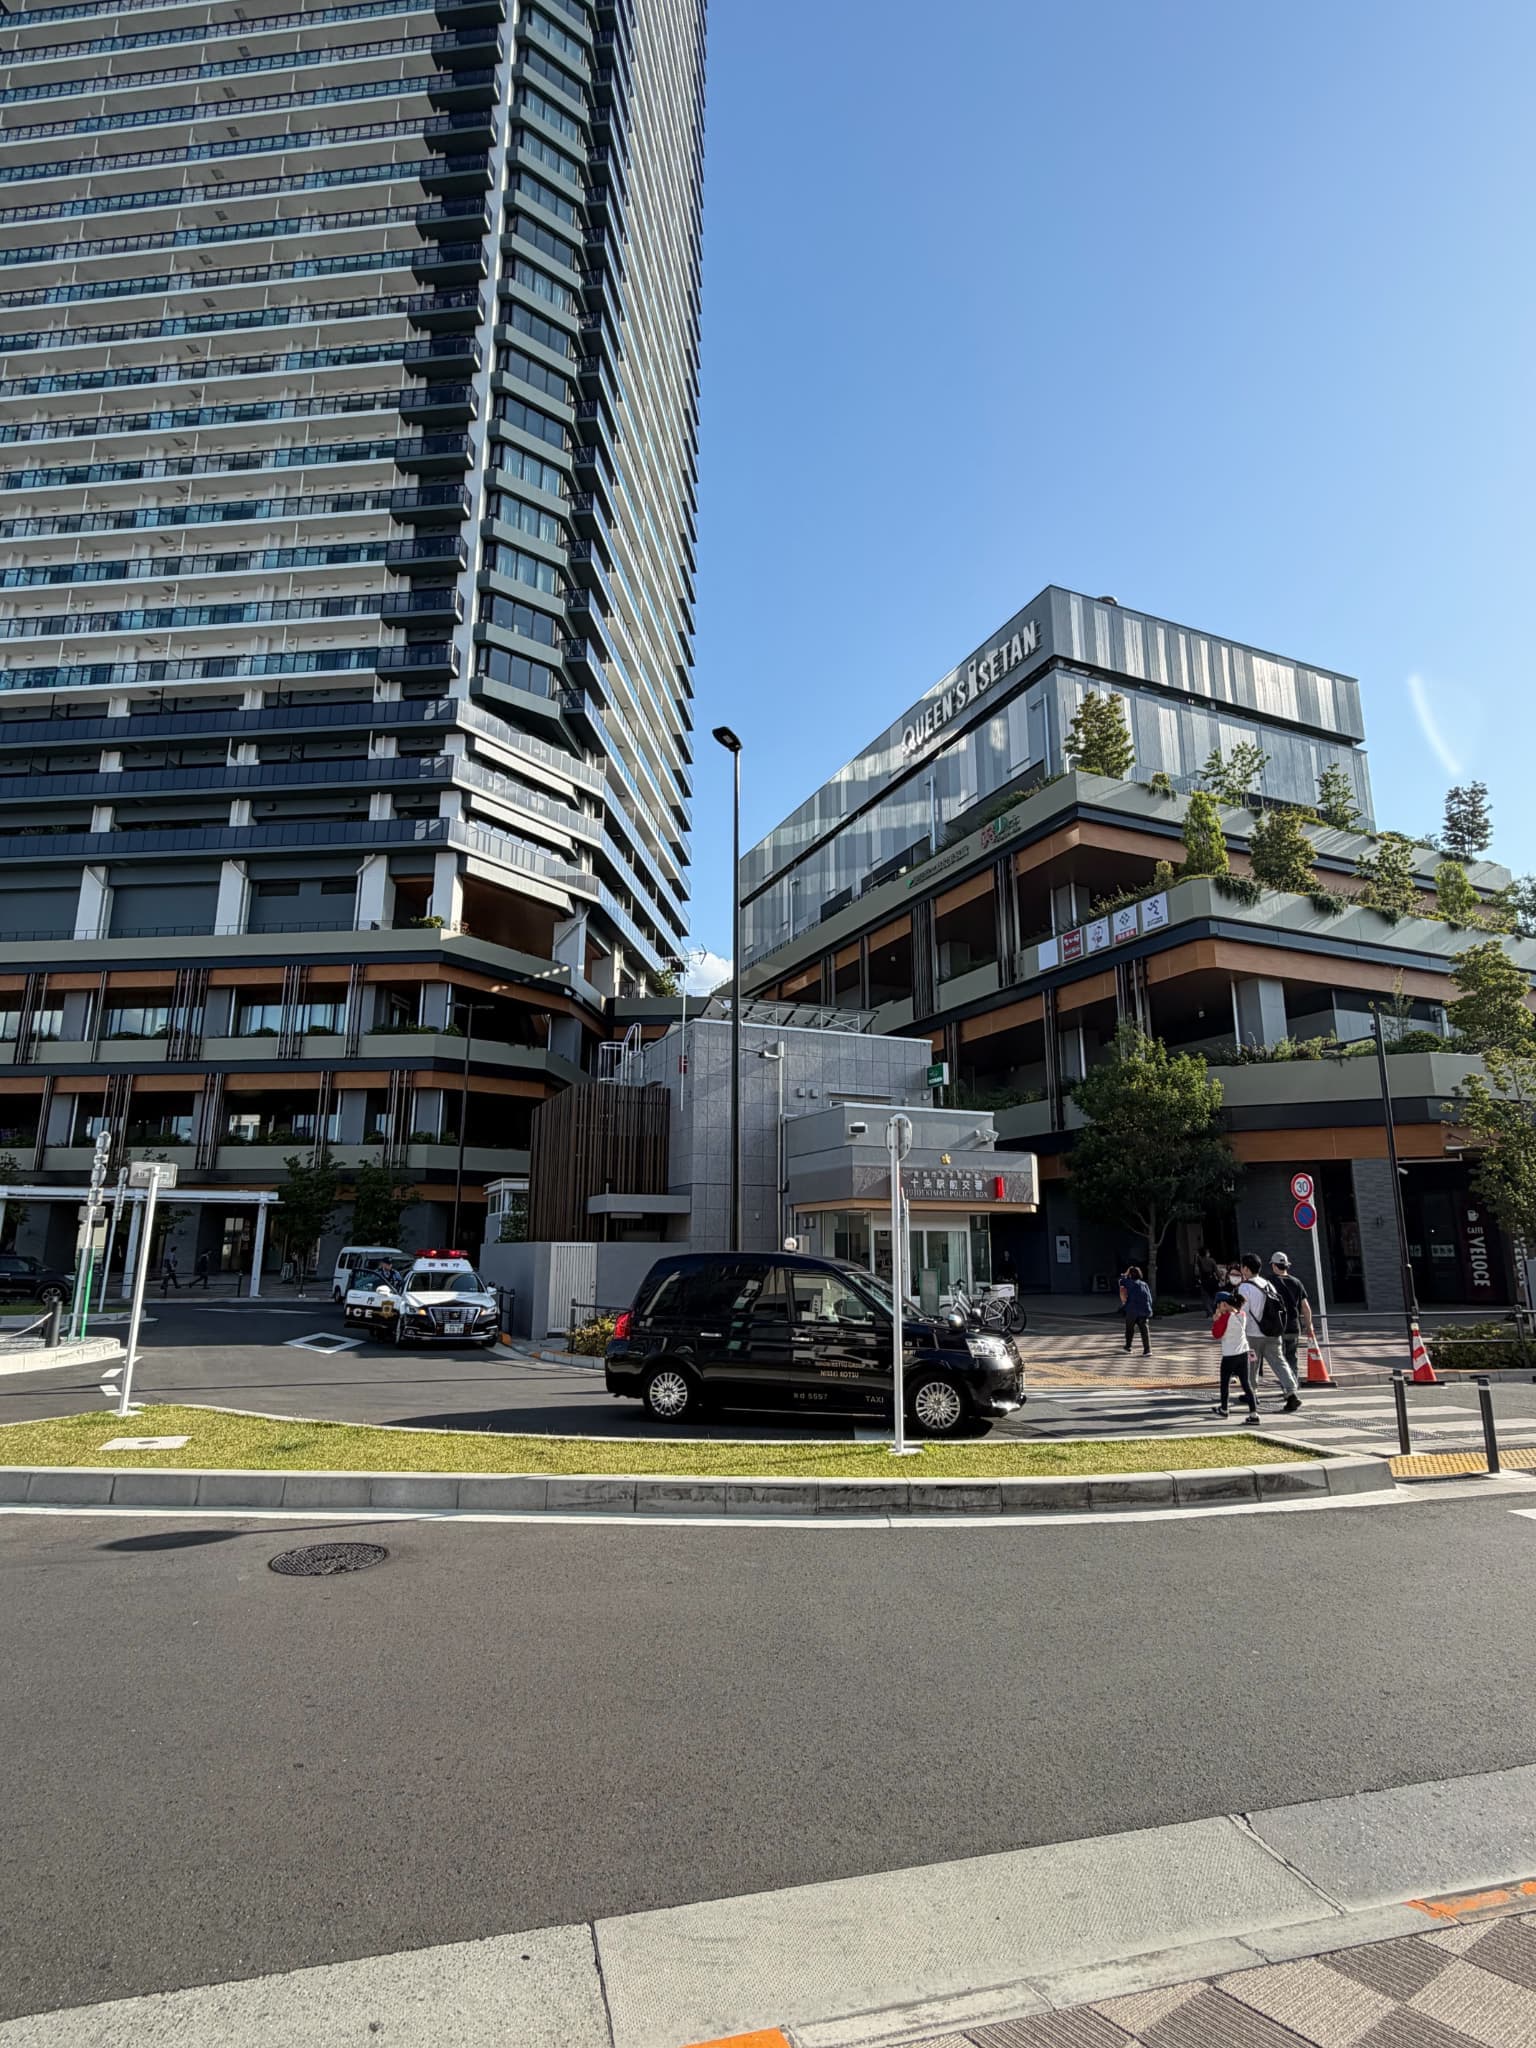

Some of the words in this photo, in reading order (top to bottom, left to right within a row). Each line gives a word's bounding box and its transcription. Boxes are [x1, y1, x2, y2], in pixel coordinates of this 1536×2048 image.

[902, 680, 966, 756] QUEEN'S
[967, 620, 1037, 703] ISETAN
[1296, 1180, 1309, 1192] 30
[1468, 1236, 1491, 1287] VELOCE
[865, 1395, 884, 1403] TAXI
